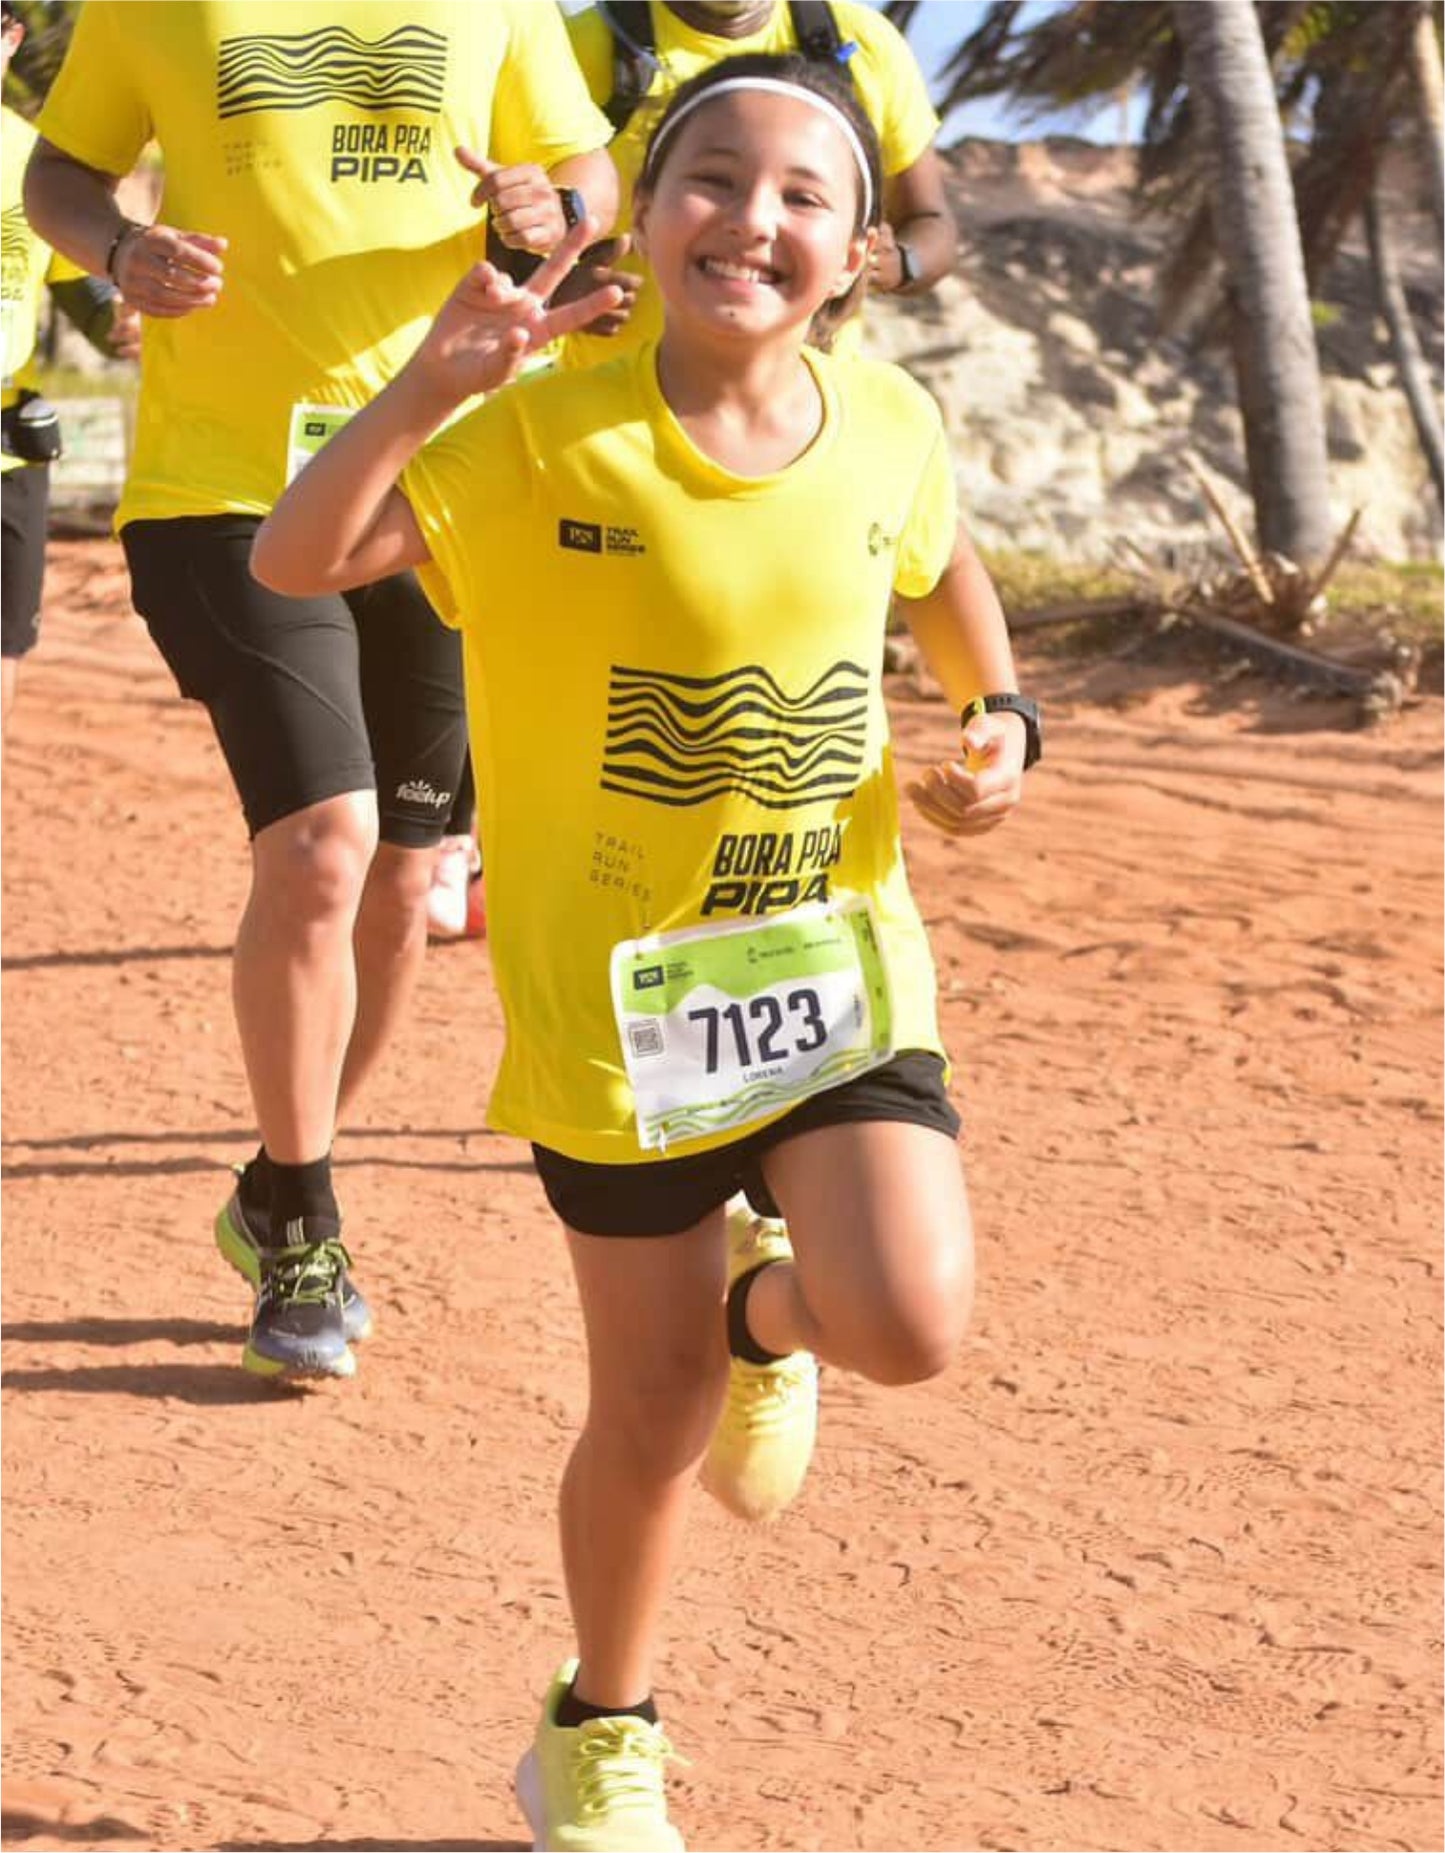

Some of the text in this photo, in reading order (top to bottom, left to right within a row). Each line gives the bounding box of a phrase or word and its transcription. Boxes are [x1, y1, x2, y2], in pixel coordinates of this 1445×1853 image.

[332, 124, 431, 154] BORA PRA
[330, 157, 428, 183] PIPA
[591, 850, 631, 873] RUN
[595, 831, 645, 860] TRAIL
[713, 823, 842, 877] BORA PRA
[589, 868, 652, 902] SERIES
[700, 873, 829, 916] PIPA
[687, 988, 828, 1074] 7123
